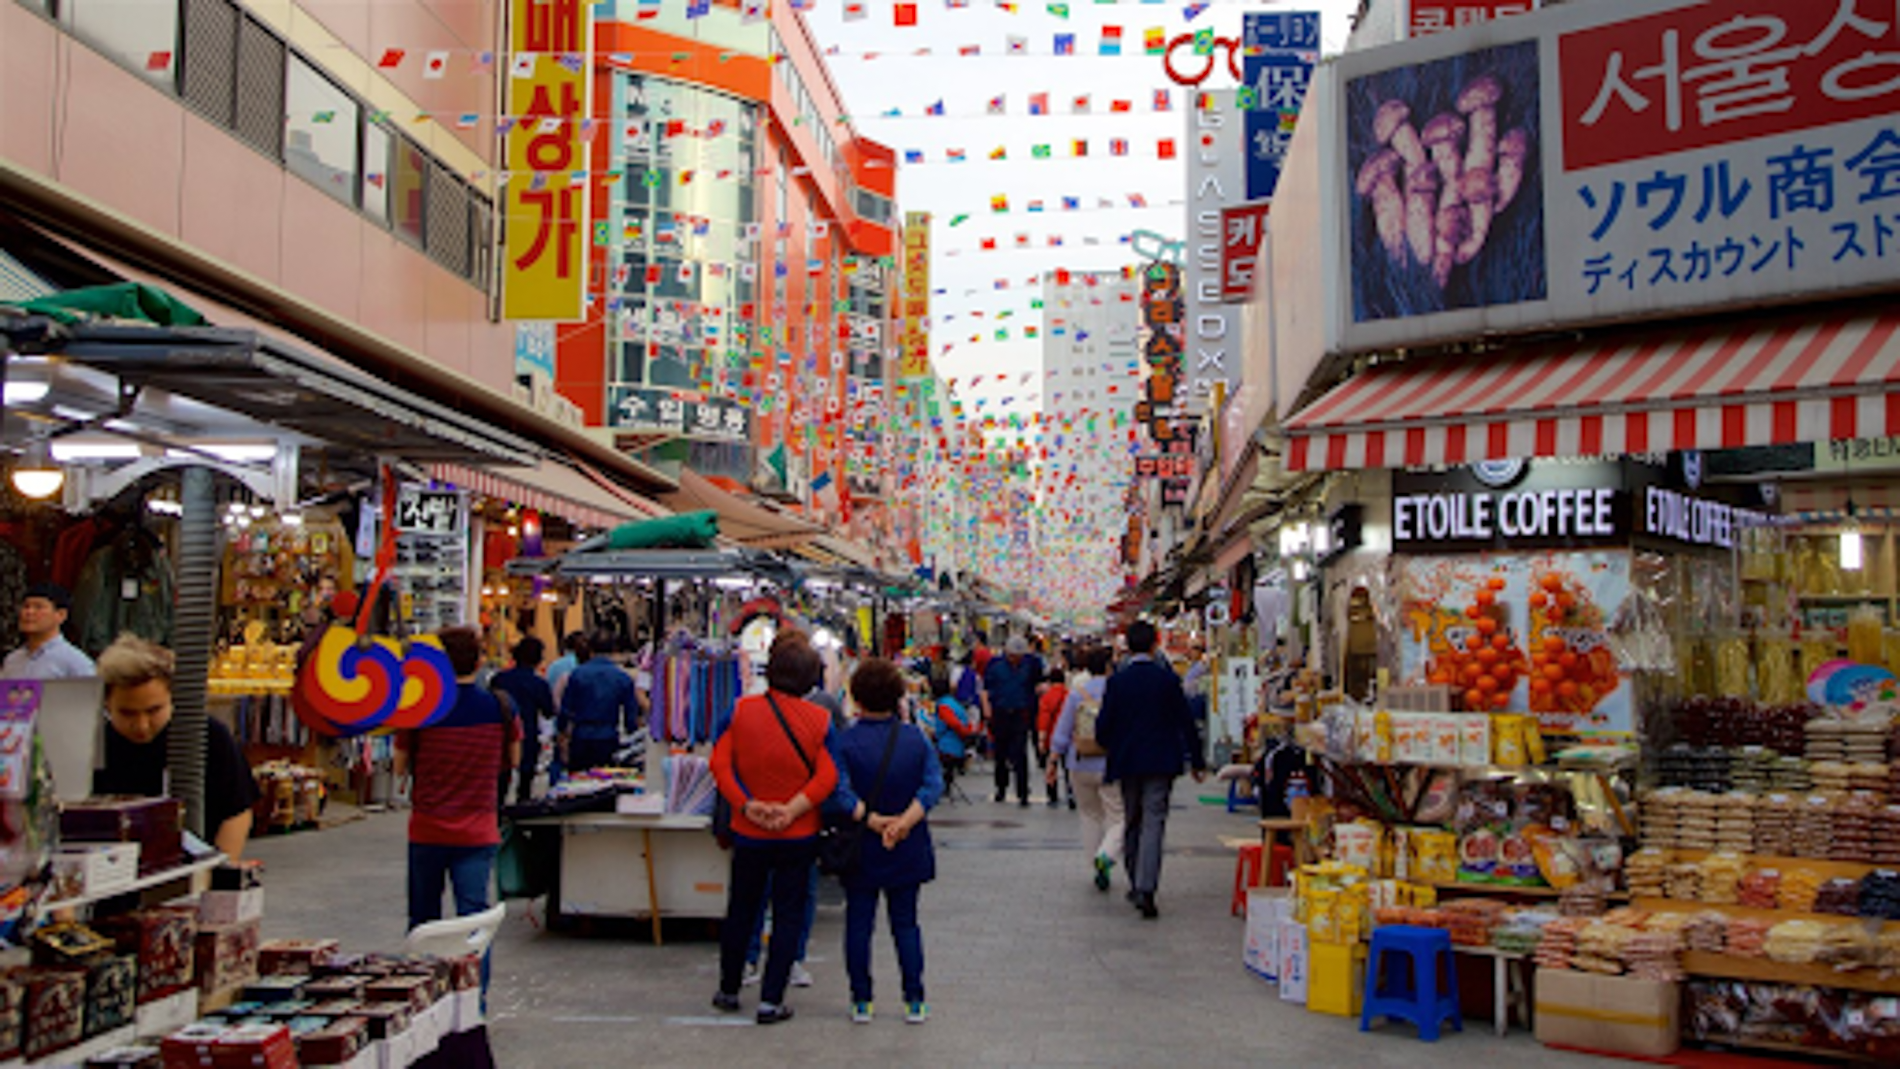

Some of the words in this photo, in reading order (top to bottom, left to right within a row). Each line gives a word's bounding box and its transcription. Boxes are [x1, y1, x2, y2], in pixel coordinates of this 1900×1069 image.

[1581, 226, 1804, 295] ディスカウント
[1830, 212, 1900, 262] スト
[1394, 495, 1494, 541] ETOILE
[1498, 488, 1615, 536] COFFEE
